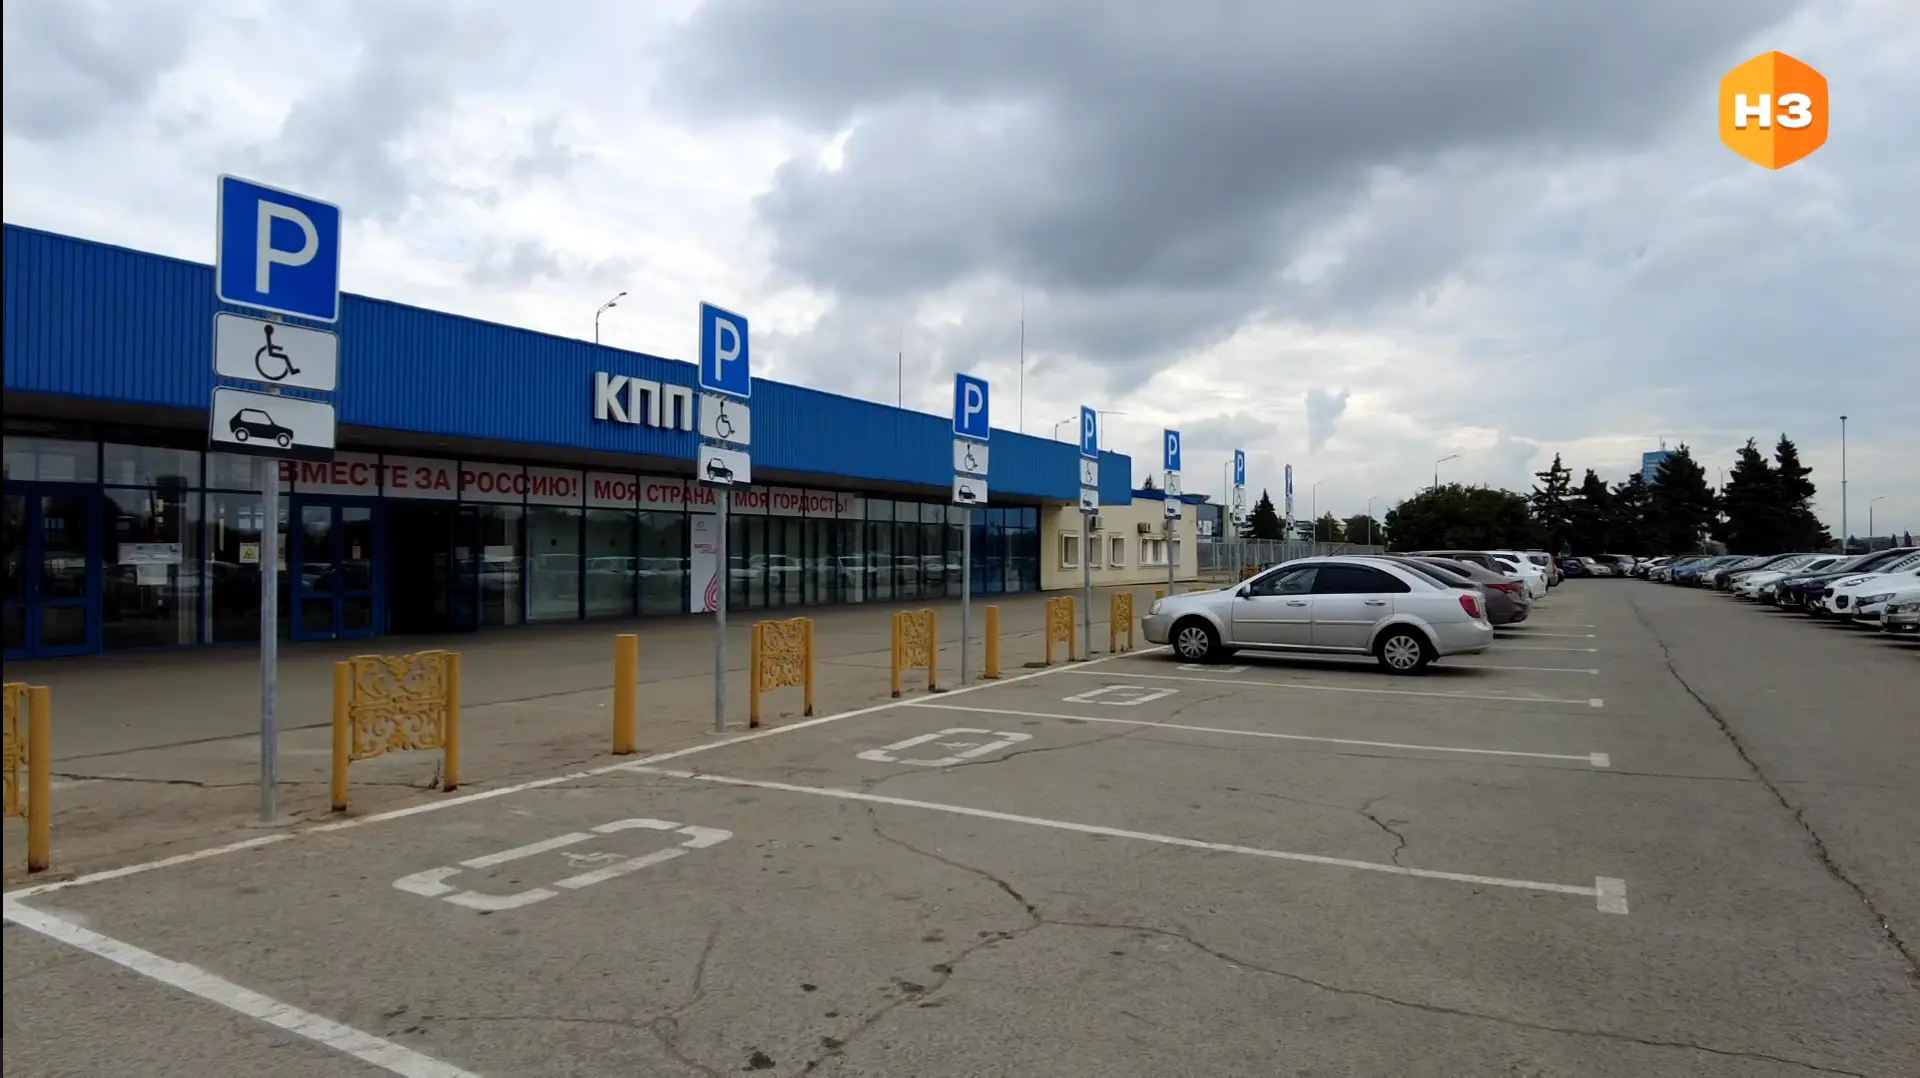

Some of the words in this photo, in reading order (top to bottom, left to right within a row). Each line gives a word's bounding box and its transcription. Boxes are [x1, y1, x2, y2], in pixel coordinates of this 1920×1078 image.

[256, 199, 319, 294] P
[715, 316, 741, 382] P
[594, 371, 693, 432] КПП
[964, 382, 983, 429] P
[1085, 412, 1094, 450] P
[1168, 434, 1178, 466] P
[278, 459, 408, 489] ВМЕСТЕ
[414, 467, 452, 491] ЗА
[460, 470, 577, 498] РОССИЮ!
[594, 479, 641, 502] МОЯ
[646, 483, 717, 506] СТРАНА
[735, 491, 768, 510] МОЯ
[773, 493, 848, 514] ГОРДОСТЬ!
